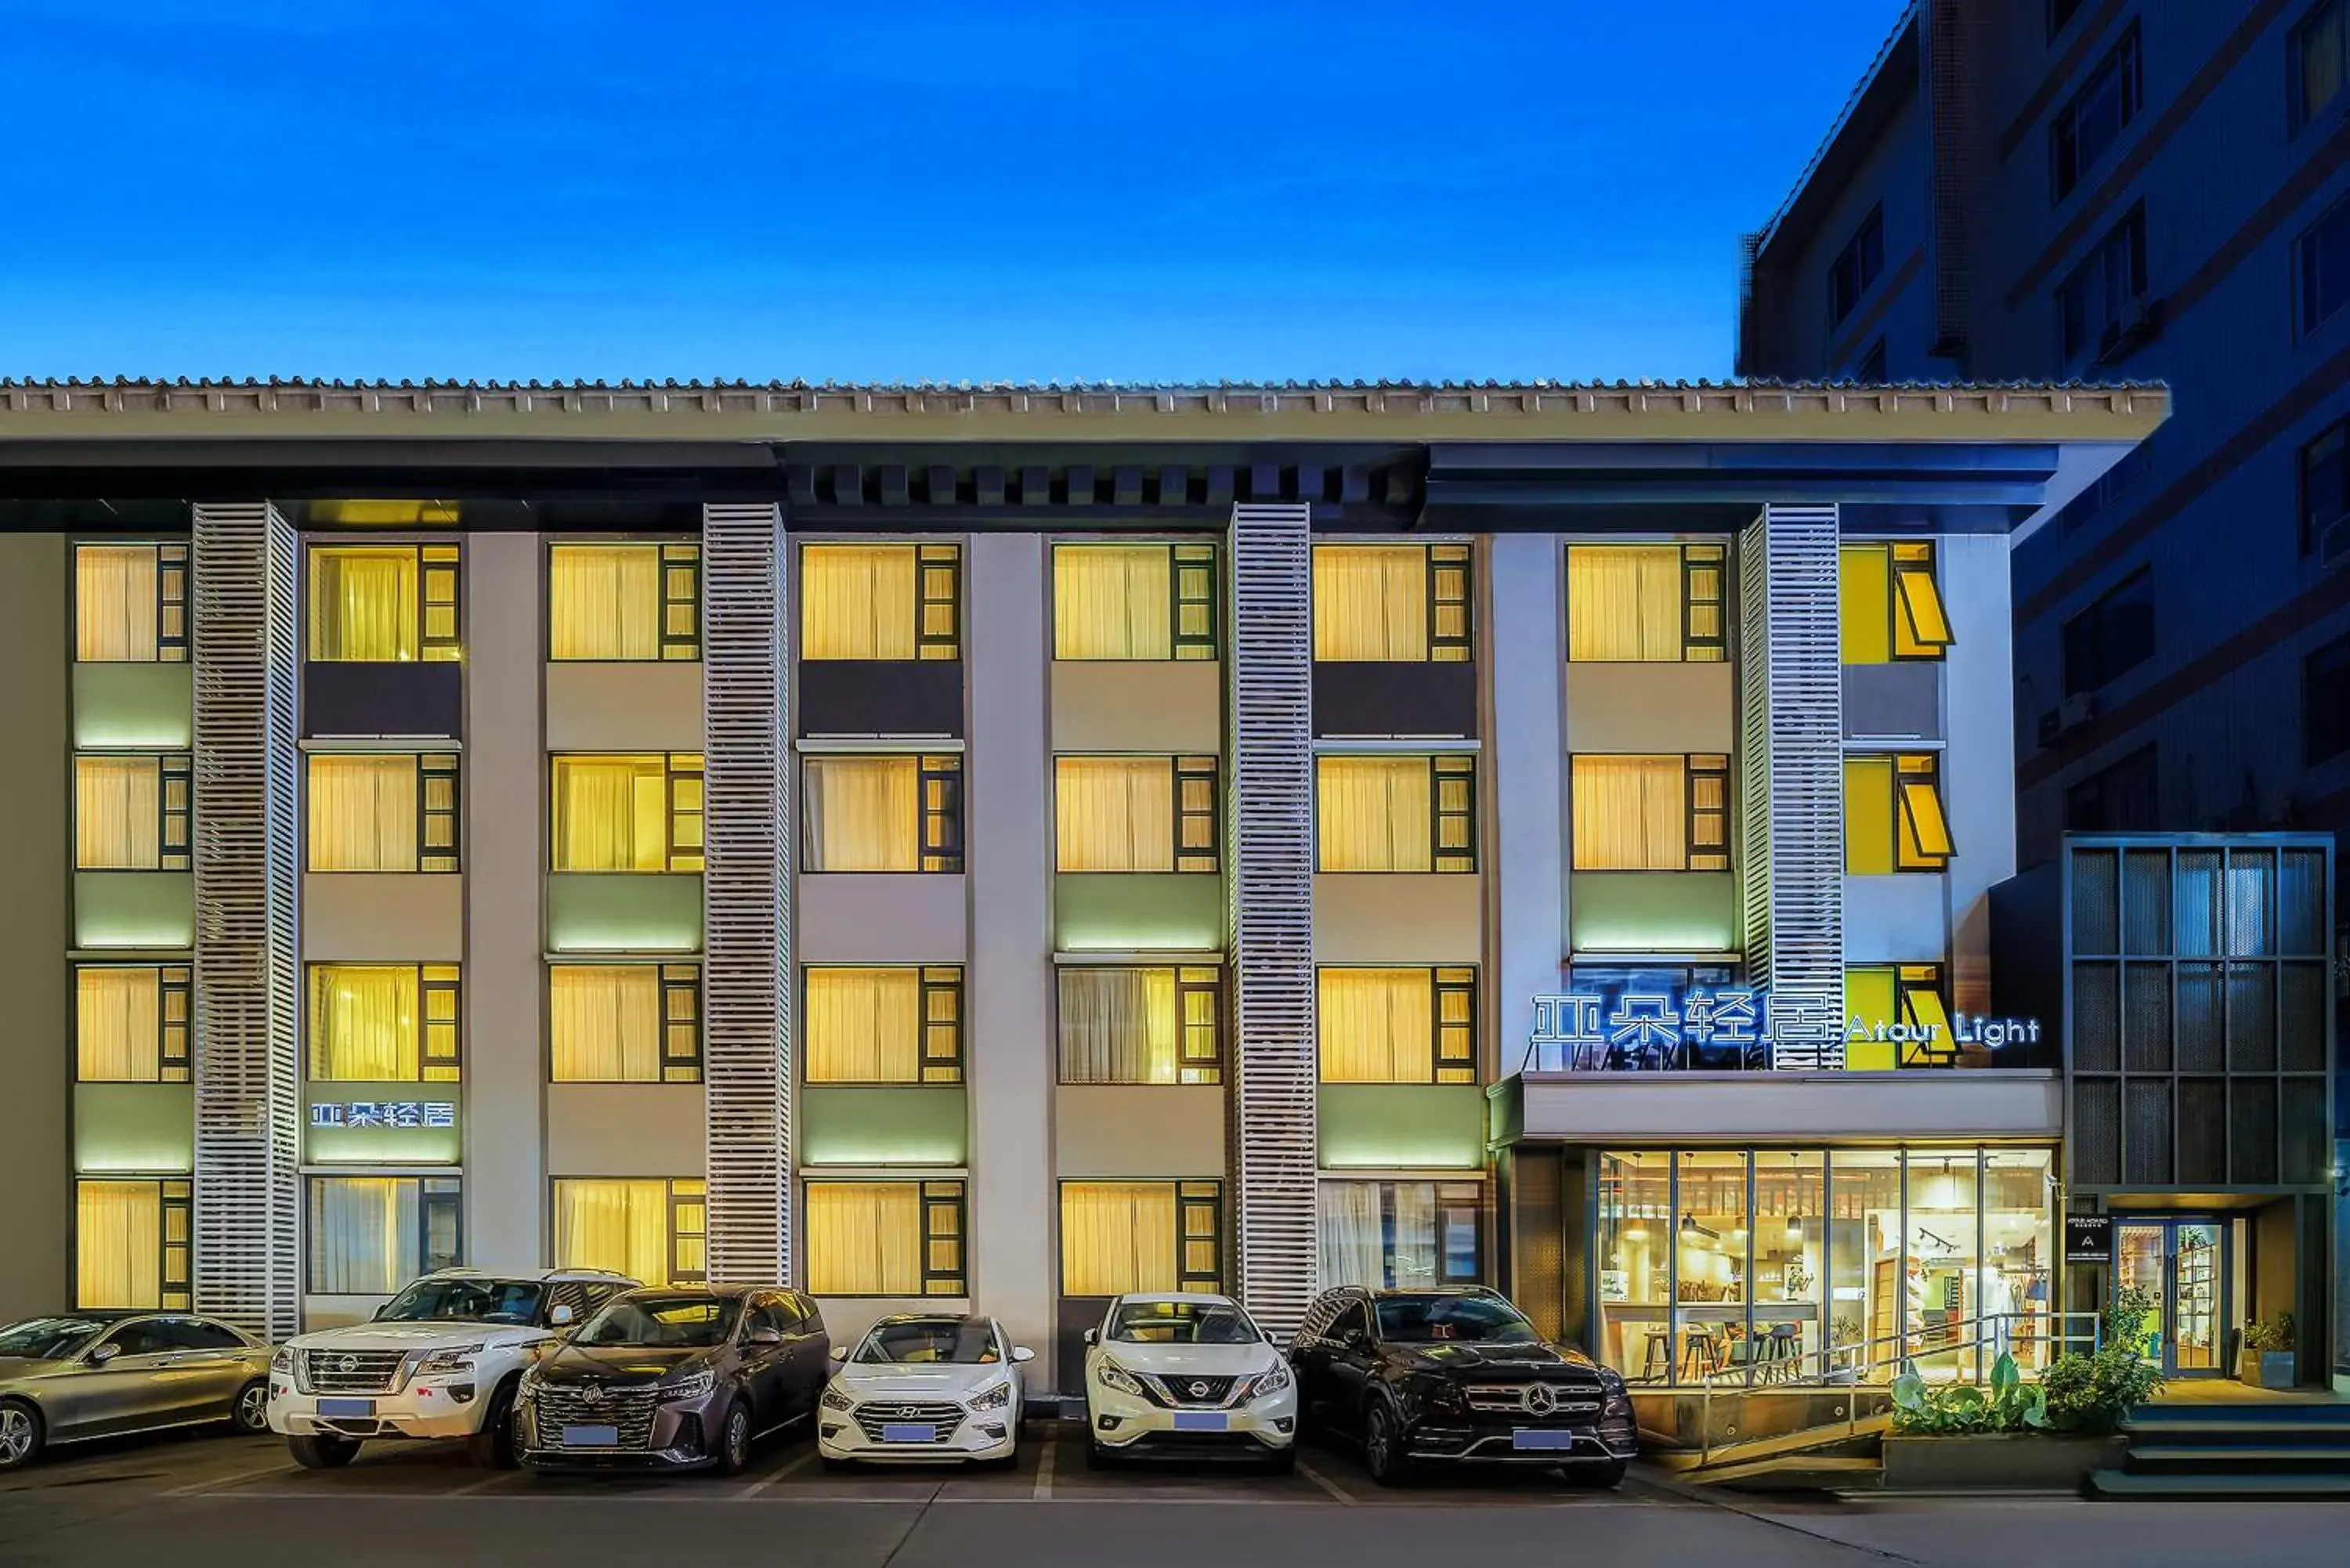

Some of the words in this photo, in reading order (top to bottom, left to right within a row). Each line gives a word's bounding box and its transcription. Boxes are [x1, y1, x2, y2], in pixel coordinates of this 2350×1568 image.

[1531, 991, 1829, 1043] 亚朵轻居
[1843, 1014, 1942, 1042] Atour
[1954, 1013, 2039, 1047] Light
[310, 1101, 454, 1128] 亚朵轻居
